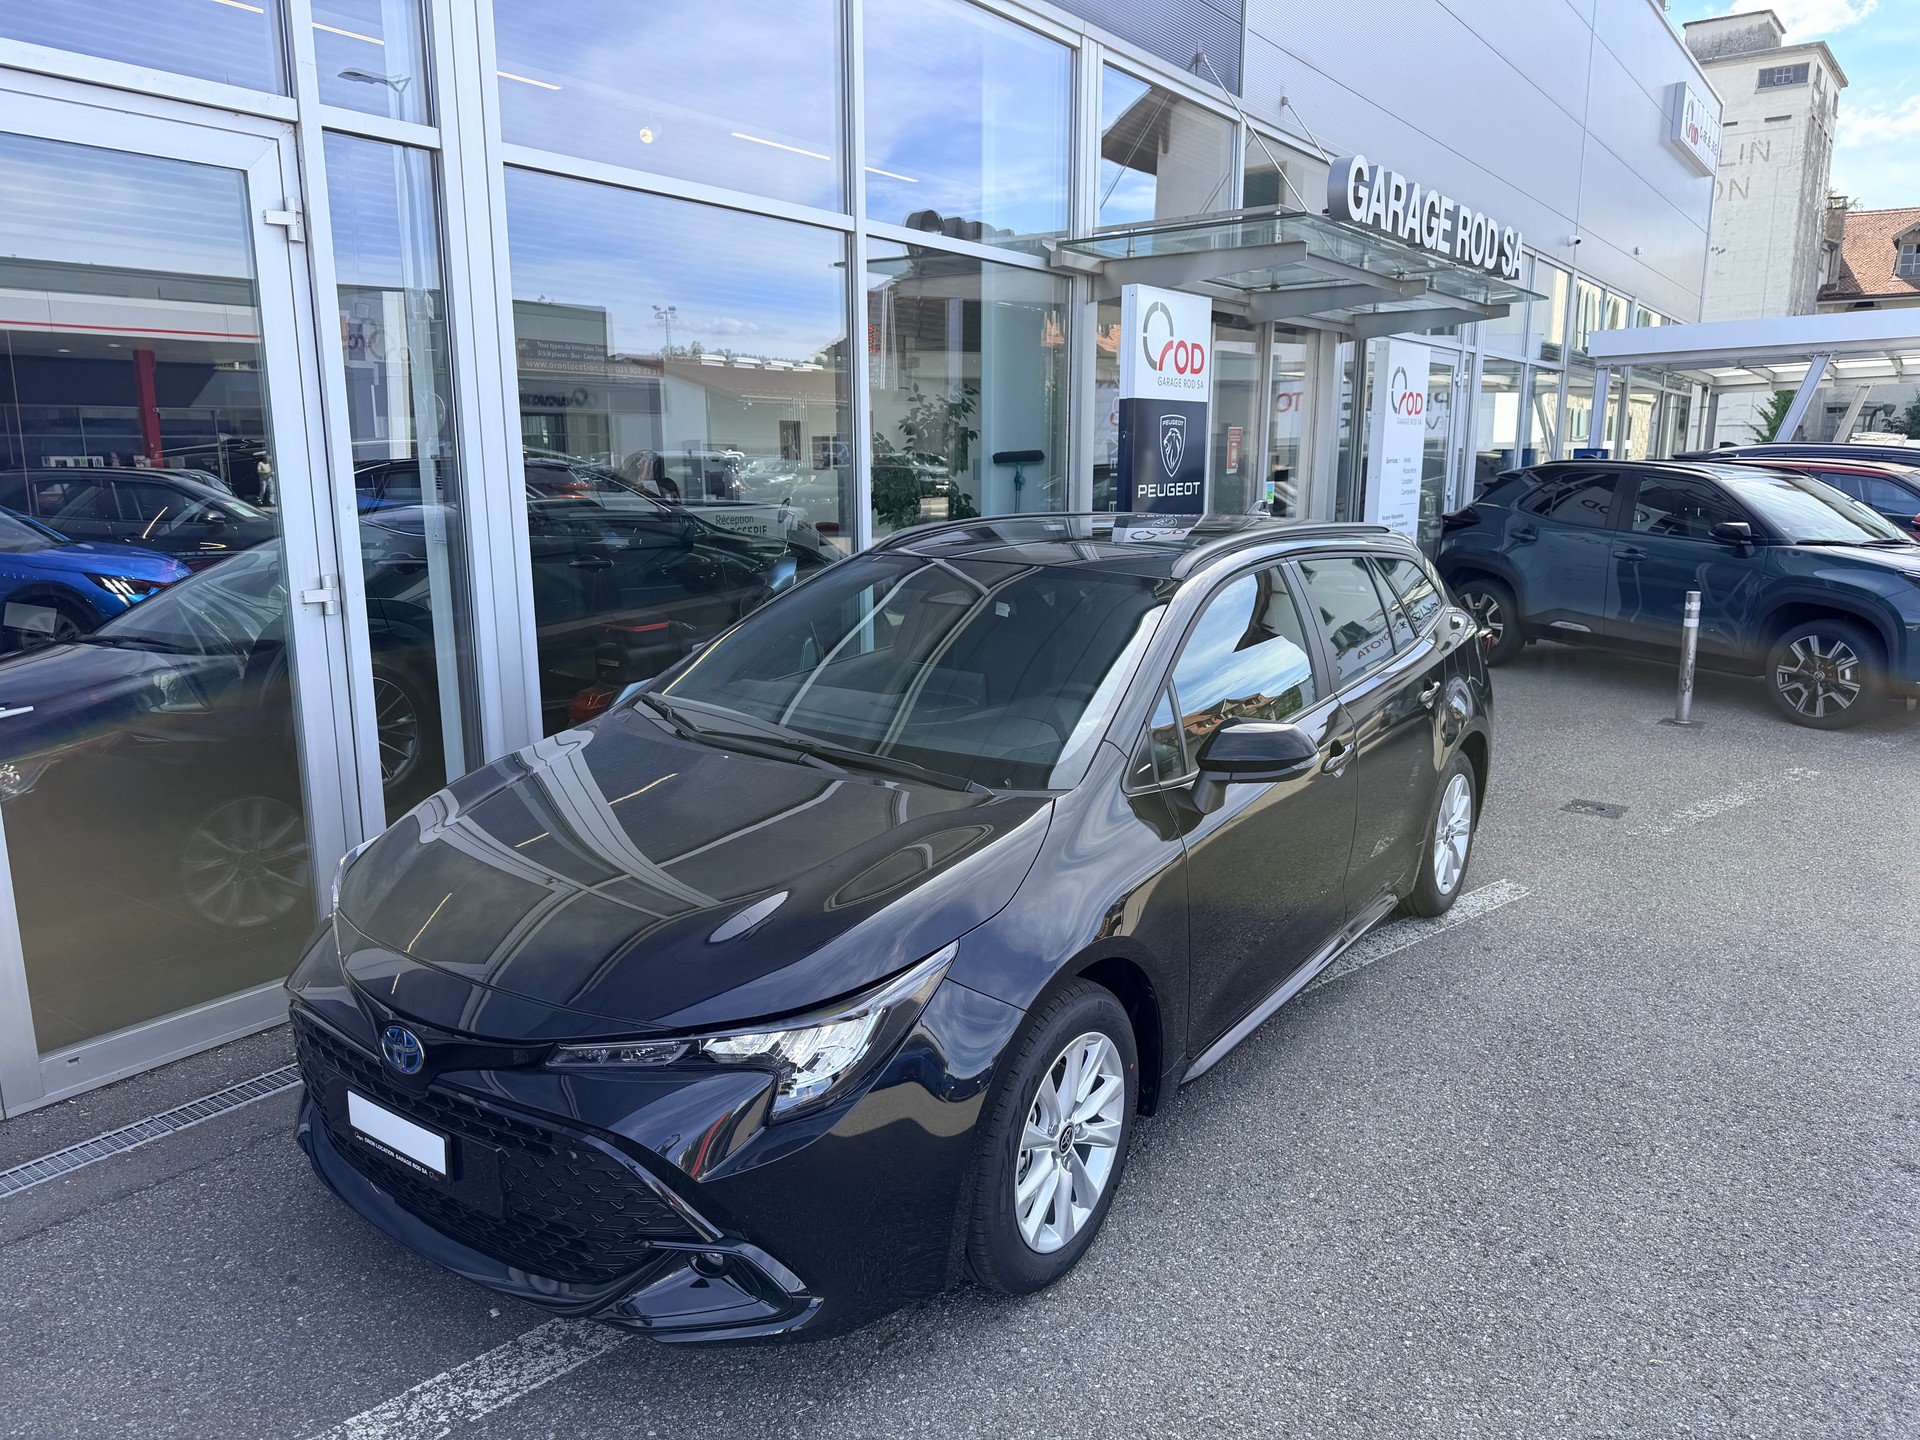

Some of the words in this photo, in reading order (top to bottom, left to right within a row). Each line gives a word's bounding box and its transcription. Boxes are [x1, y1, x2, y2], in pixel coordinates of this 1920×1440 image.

[1347, 154, 1454, 255] GARAGE
[1455, 204, 1499, 270] ROD
[1501, 225, 1523, 280] SA
[1157, 376, 1182, 388] GARAGE
[1183, 378, 1196, 389] ROD
[1196, 380, 1204, 389] SA
[1137, 481, 1201, 498] PEUGEOT
[715, 514, 754, 527] Réception
